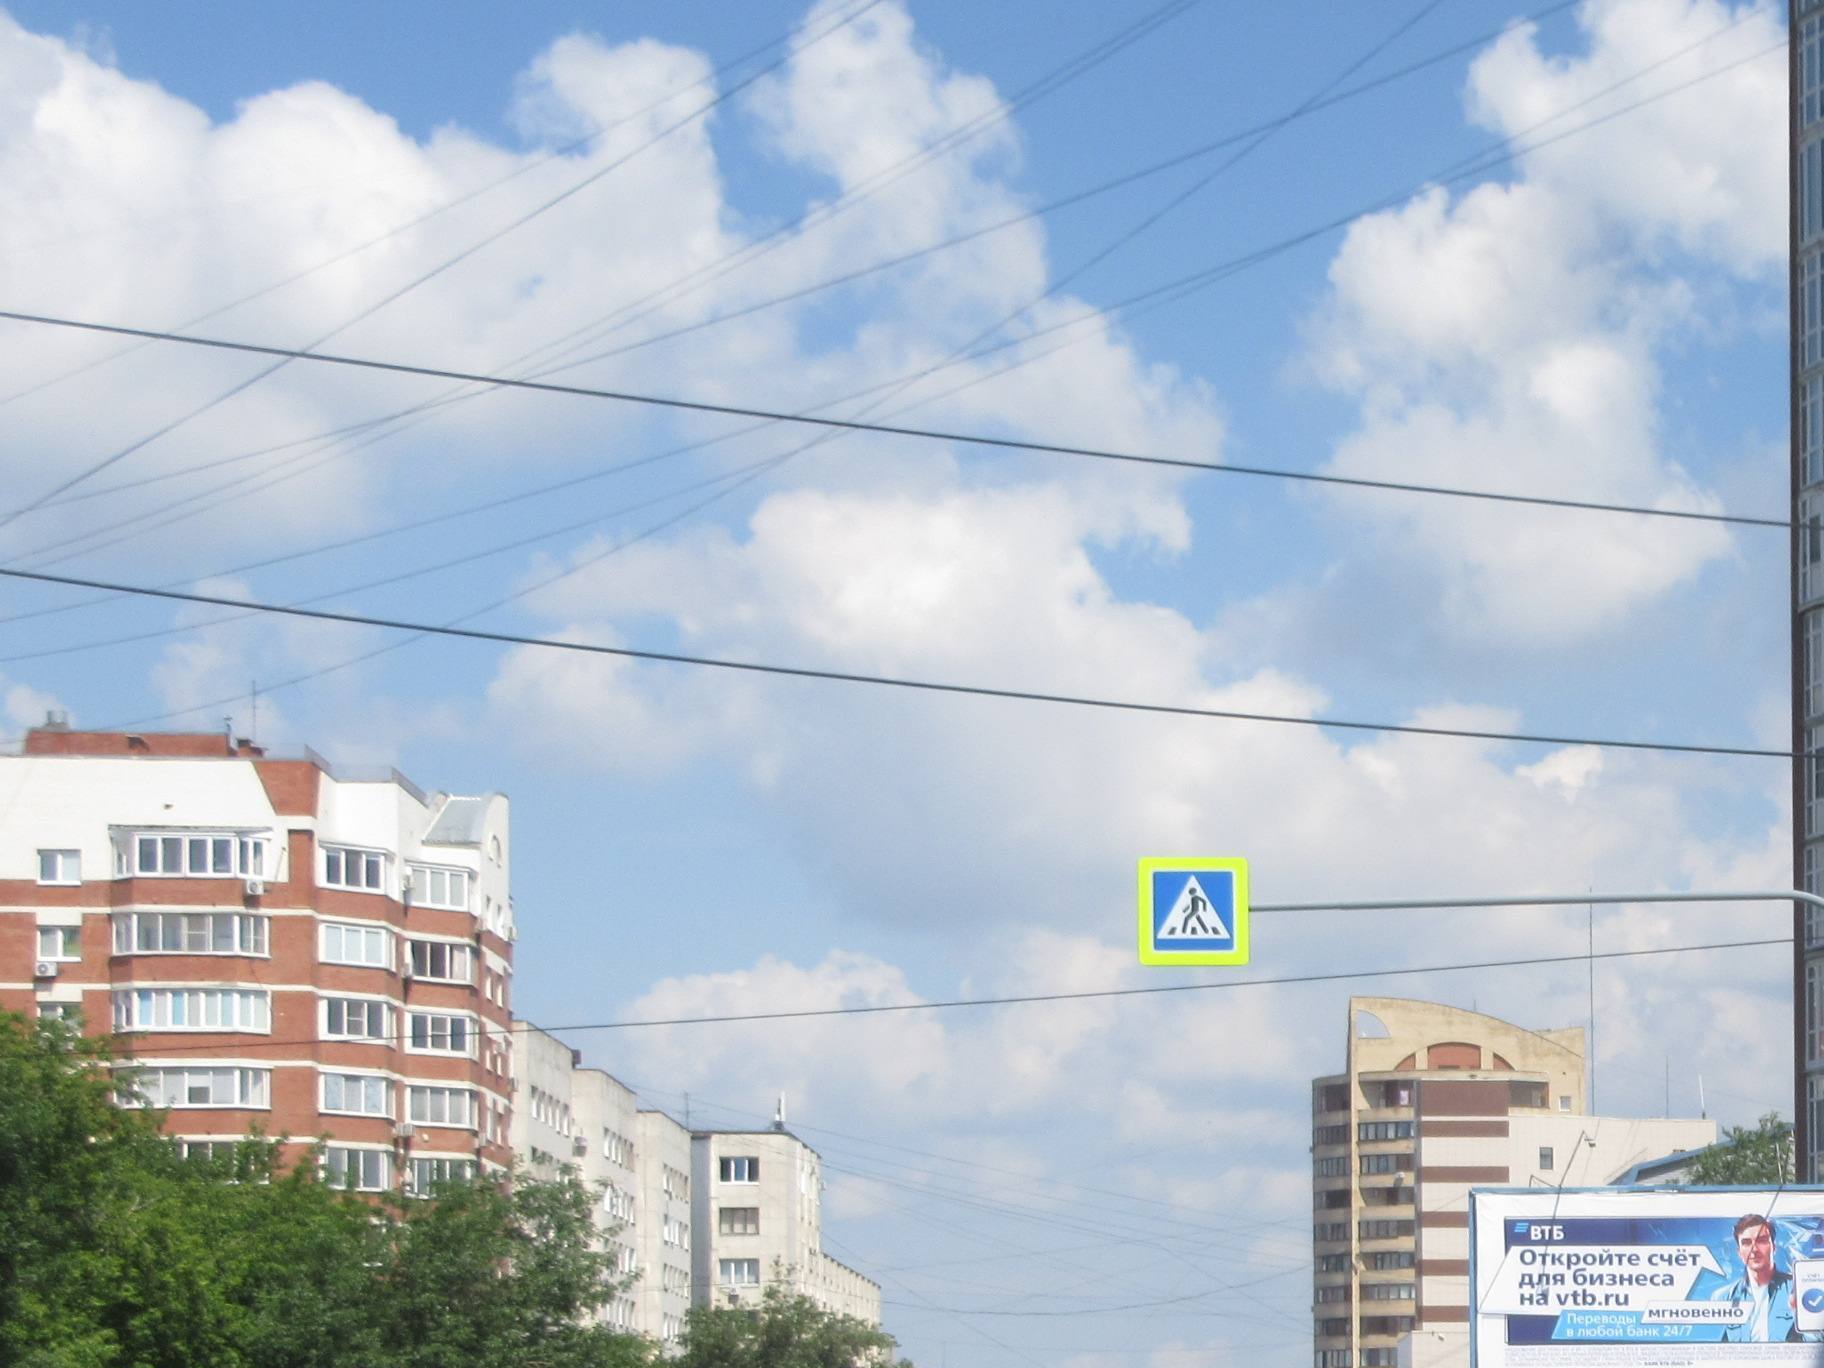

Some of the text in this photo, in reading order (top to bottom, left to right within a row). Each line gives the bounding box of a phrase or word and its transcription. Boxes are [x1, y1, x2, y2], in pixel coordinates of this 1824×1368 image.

[1530, 1225, 1564, 1241] ВТБ
[1519, 1248, 1701, 1270] Откройте счёт
[1518, 1268, 1675, 1288] для бизнеса
[1519, 1287, 1630, 1307] на vtb.ru
[1567, 1306, 1744, 1327] Переводы мгновенно
[1566, 1323, 1693, 1338] в любой банк 24/7
